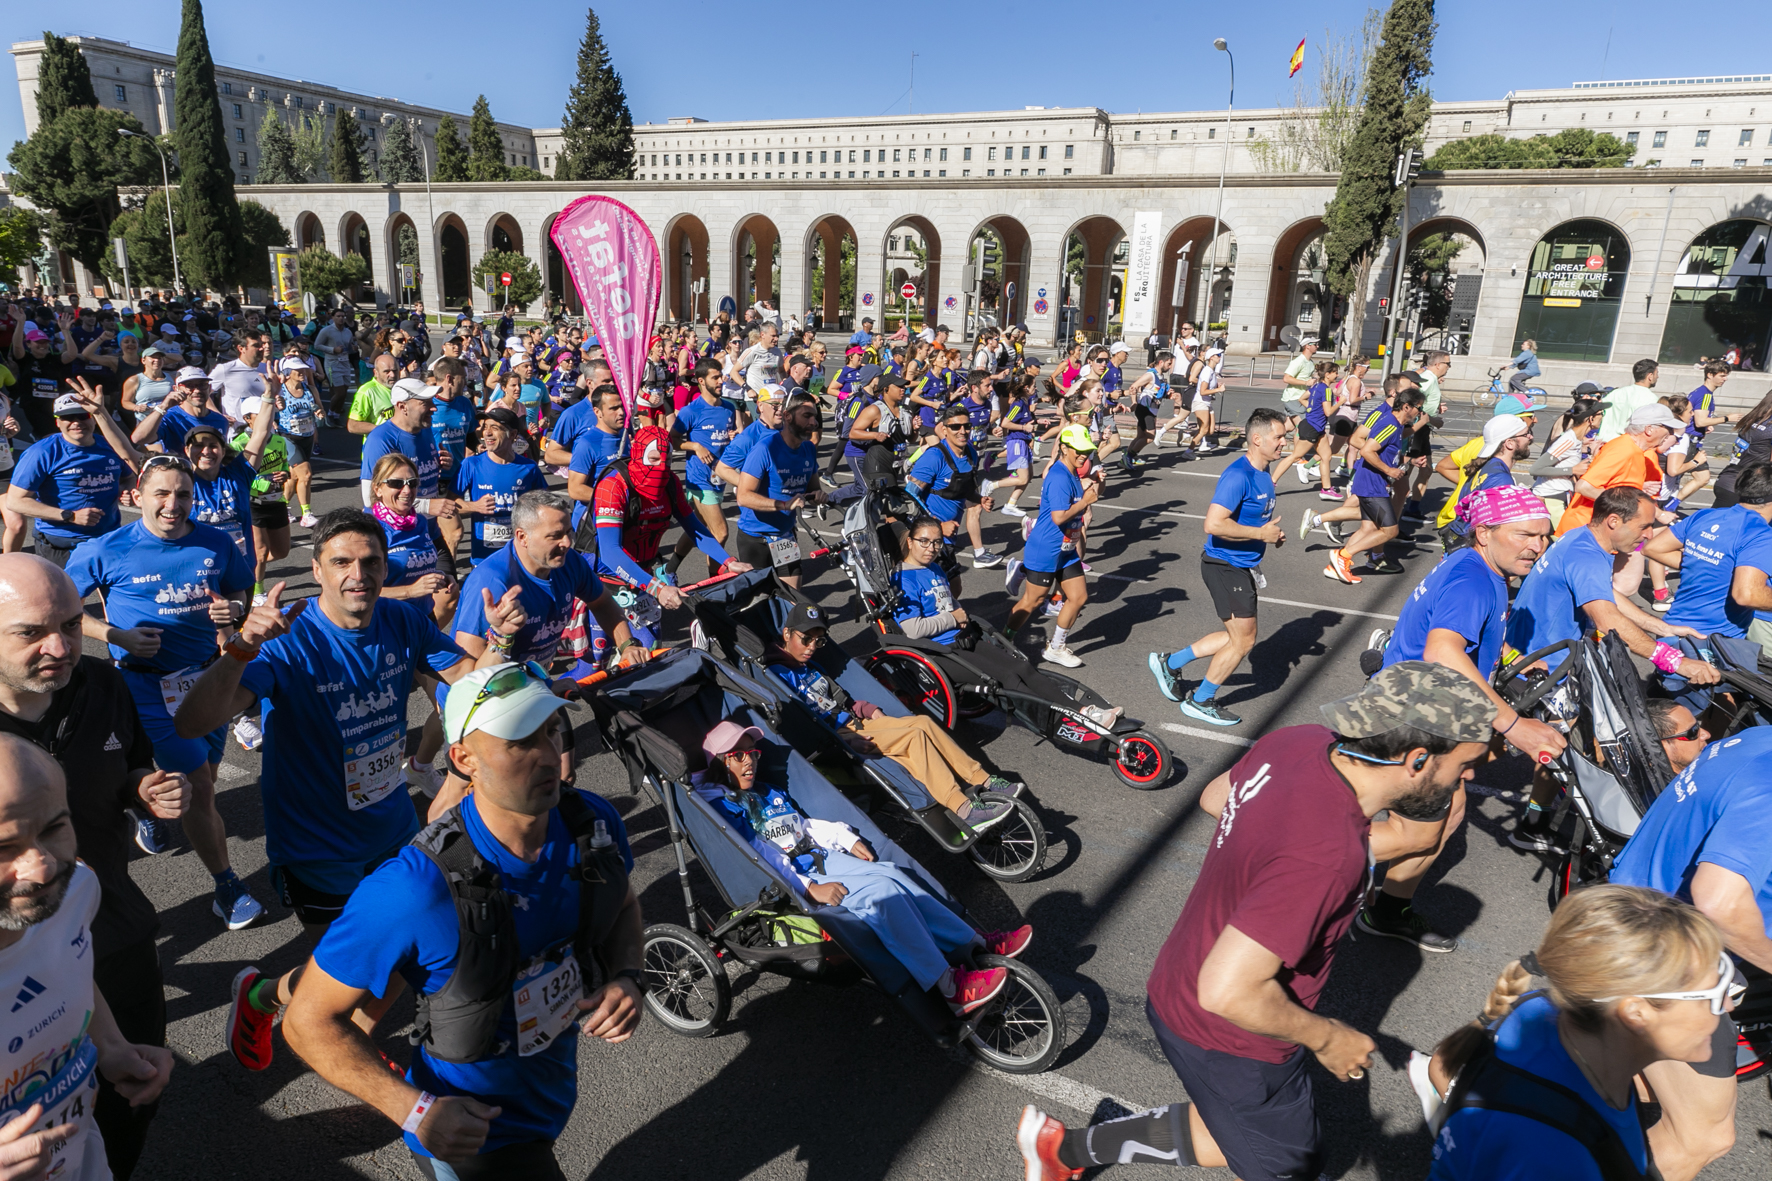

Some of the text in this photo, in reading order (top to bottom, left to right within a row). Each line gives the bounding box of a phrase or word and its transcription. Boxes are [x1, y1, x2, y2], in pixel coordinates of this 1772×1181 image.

[1142, 223, 1148, 232] LA
[1140, 234, 1146, 248] DE
[1141, 235, 1153, 298] ARQUITECTURA
[1554, 263, 1586, 272] GREAT
[1136, 268, 1142, 281] LA
[1535, 272, 1612, 282] ARCHITECTURE,
[1552, 280, 1576, 288] FREE
[1550, 289, 1599, 298] ENTRANCE
[1714, 551, 1725, 560] AT
[196, 568, 221, 576] ZURICH
[132, 574, 162, 584] aefat
[158, 602, 210, 616] #Imparables
[380, 664, 408, 682] ZURICH
[342, 714, 398, 739] #Imparables
[373, 726, 402, 750] ZURICH
[104, 742, 122, 752] adidas
[368, 752, 396, 776] 3356
[964, 988, 976, 1002] N
[27, 1006, 66, 1040] ZURICH
